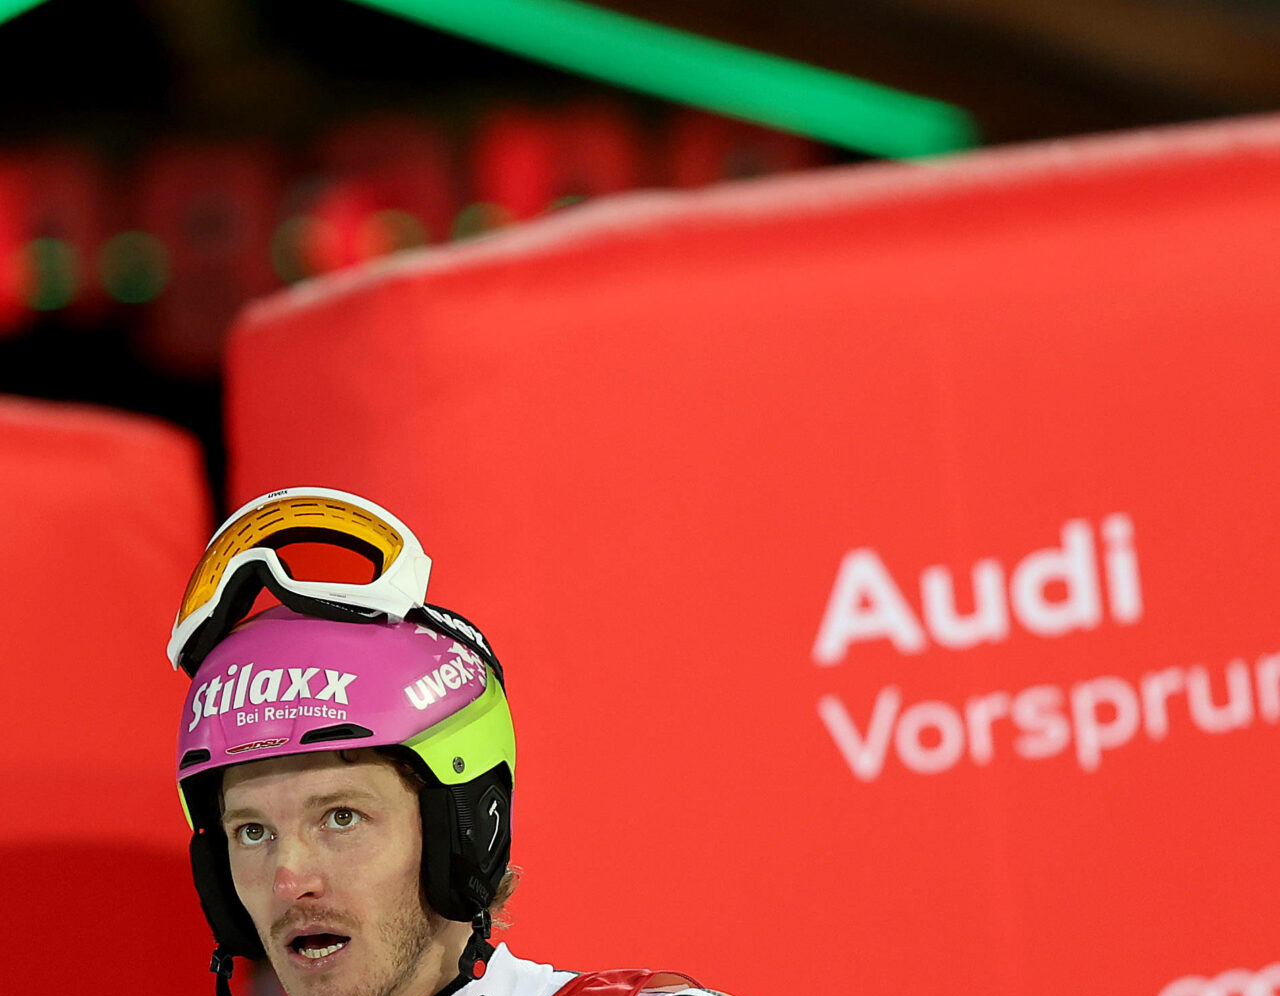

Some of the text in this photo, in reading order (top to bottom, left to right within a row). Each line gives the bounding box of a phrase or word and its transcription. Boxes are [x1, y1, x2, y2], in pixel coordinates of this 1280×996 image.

[812, 511, 1143, 667] Audi
[188, 662, 358, 733] Stilaxx
[404, 656, 474, 711] uvex
[236, 709, 259, 727] Bei
